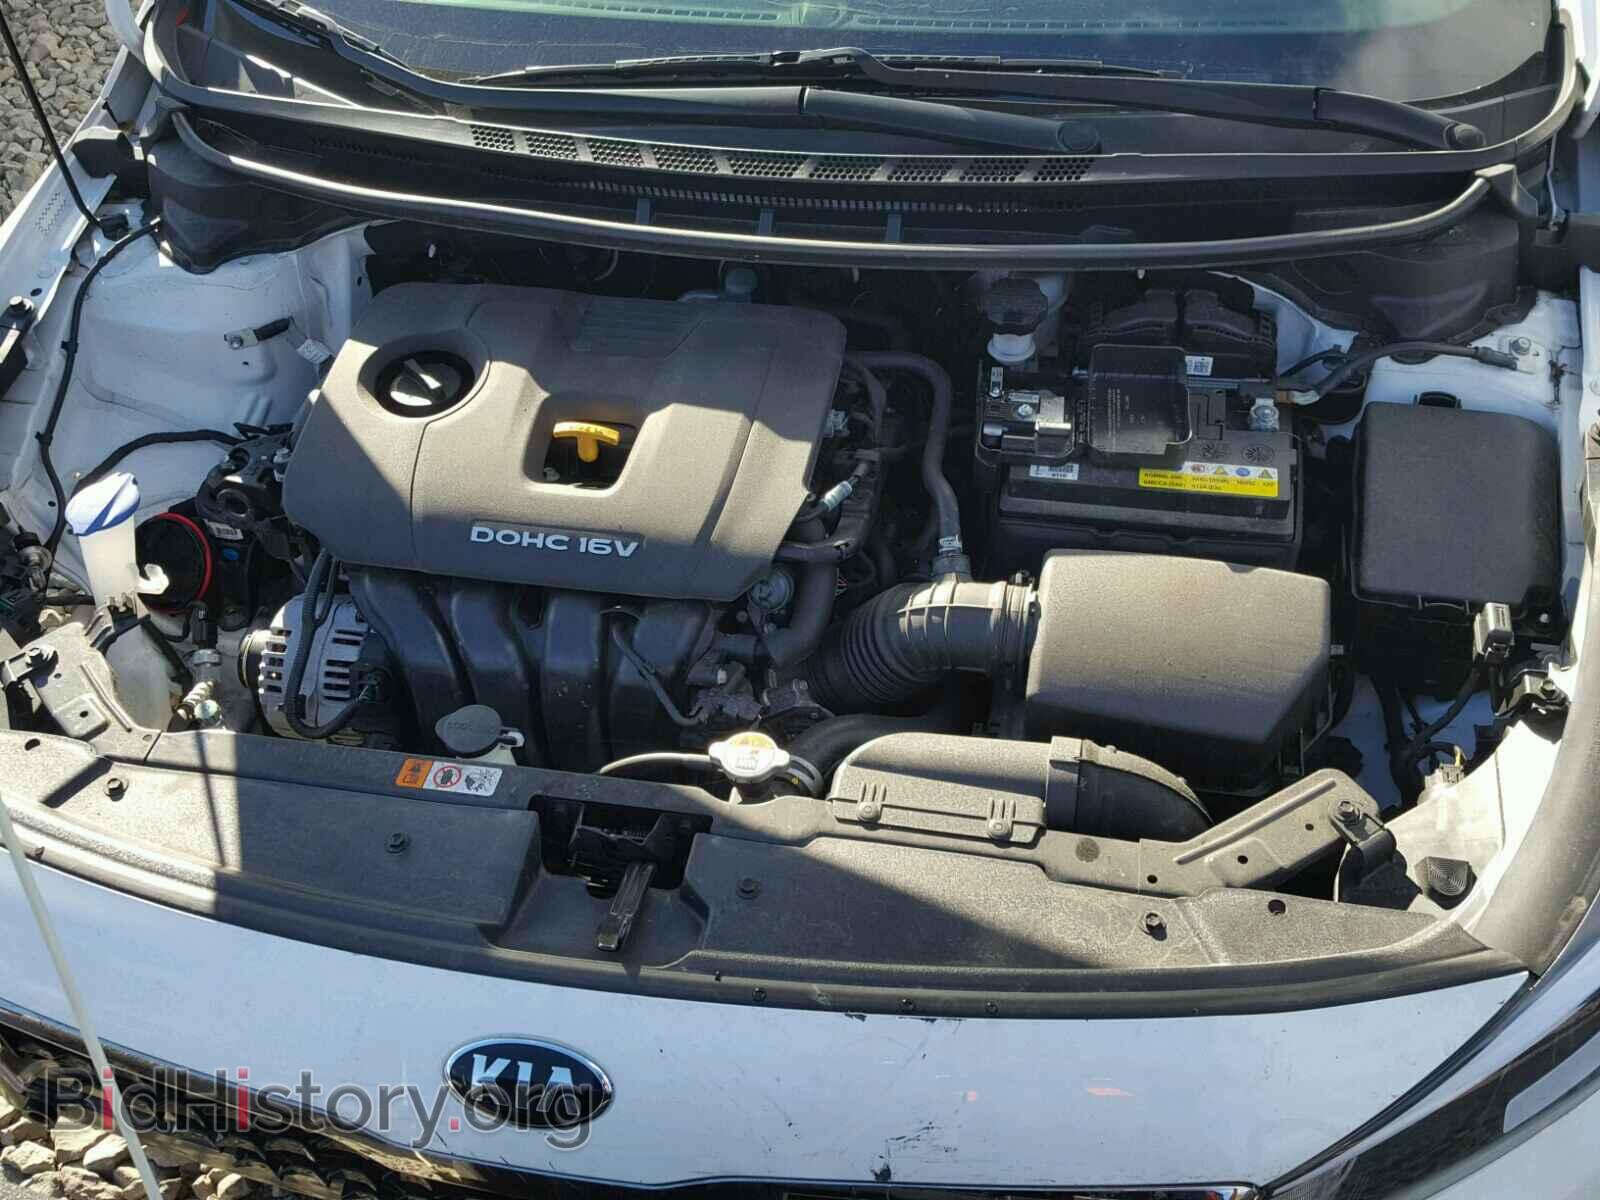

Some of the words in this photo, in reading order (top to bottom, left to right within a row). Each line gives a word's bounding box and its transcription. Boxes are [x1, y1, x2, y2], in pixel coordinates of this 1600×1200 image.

[470, 526, 571, 551] DOHC
[579, 537, 639, 557] 16V
[471, 1053, 581, 1116] KIA
